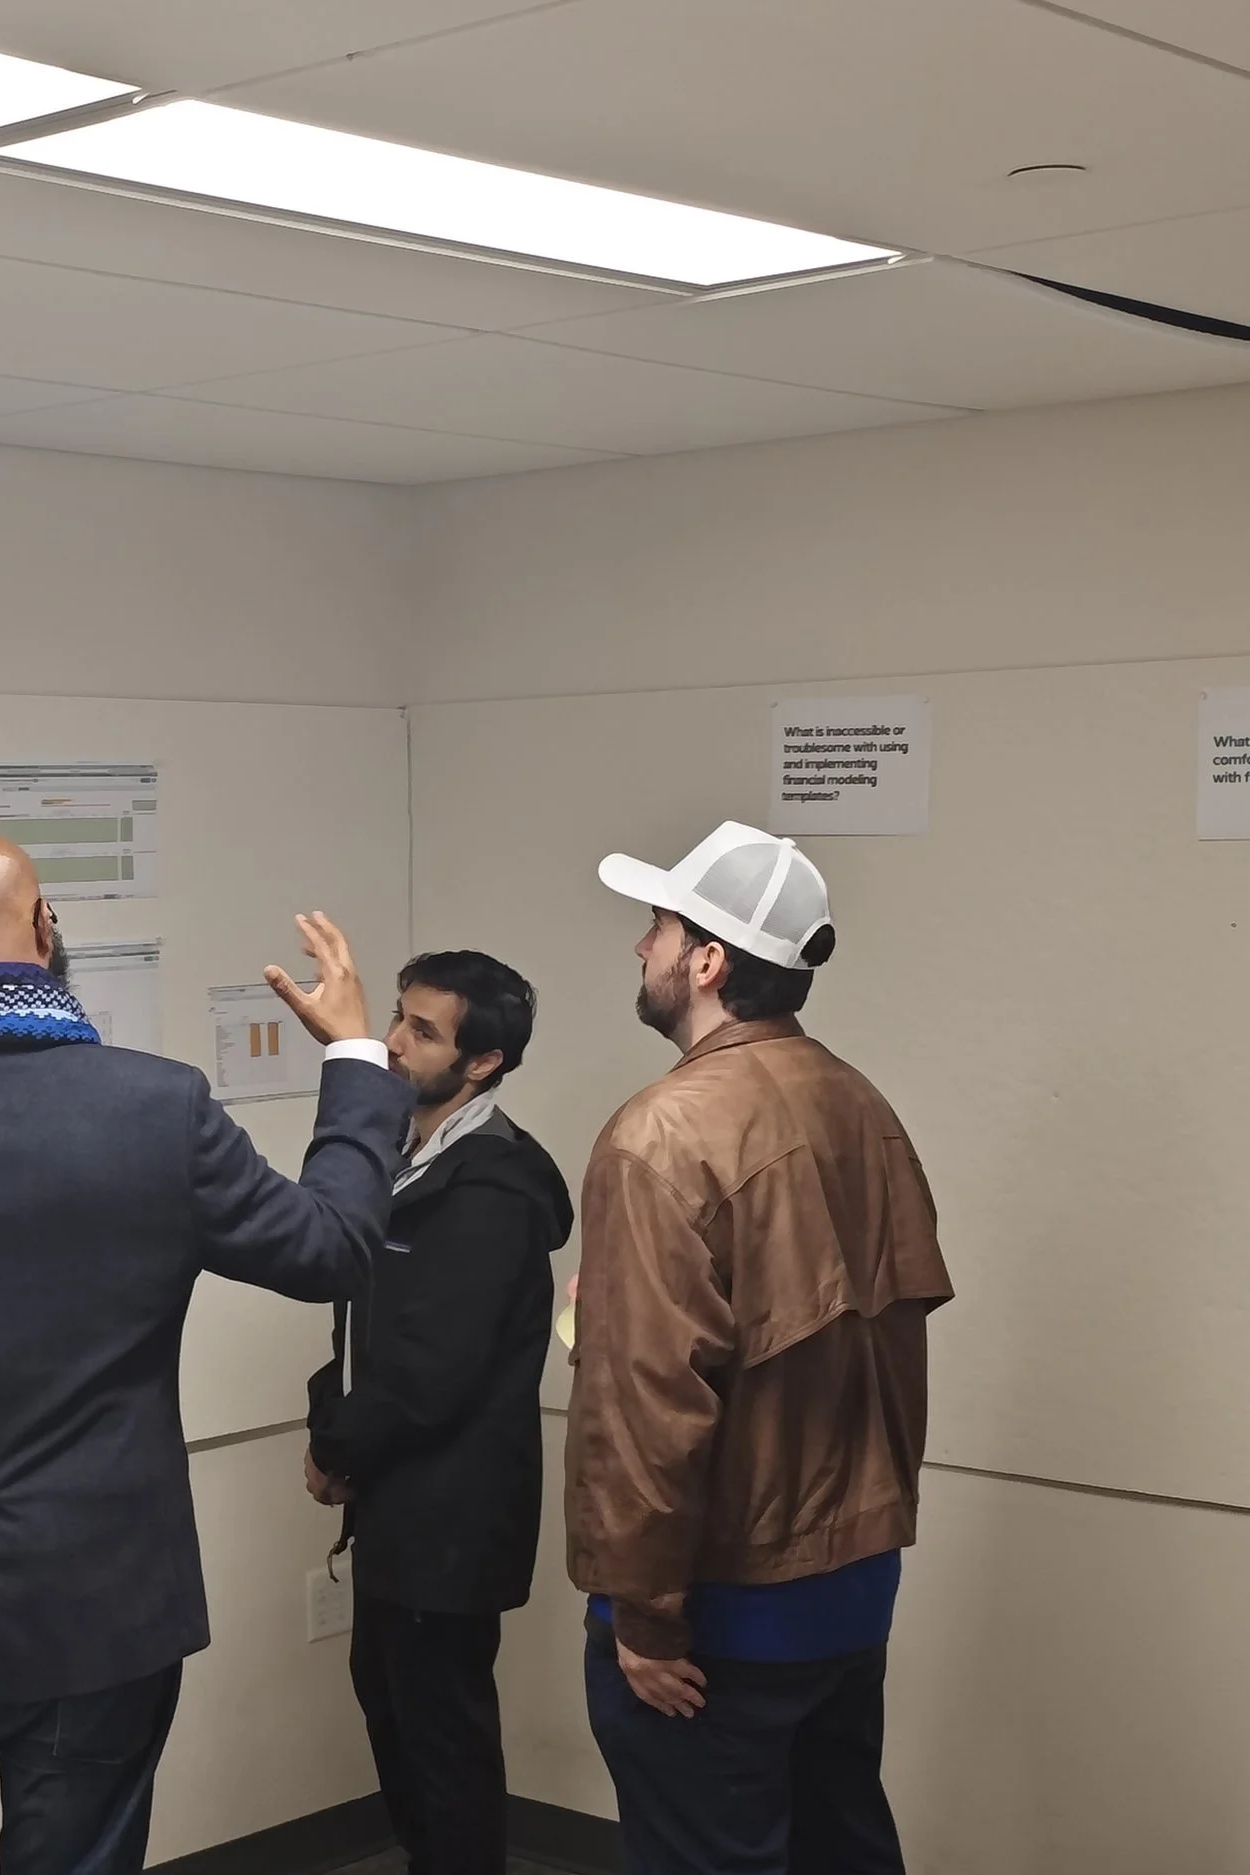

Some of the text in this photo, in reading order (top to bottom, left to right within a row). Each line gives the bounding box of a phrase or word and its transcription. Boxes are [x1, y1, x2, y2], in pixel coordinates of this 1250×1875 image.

[784, 725, 905, 737] What is inaccessible or
[1213, 735, 1250, 747] What
[783, 741, 909, 754] troublesome with using
[783, 758, 877, 771] and implementing
[782, 774, 877, 787] financial modeling
[1213, 771, 1241, 783] with
[781, 791, 840, 803] templates?
